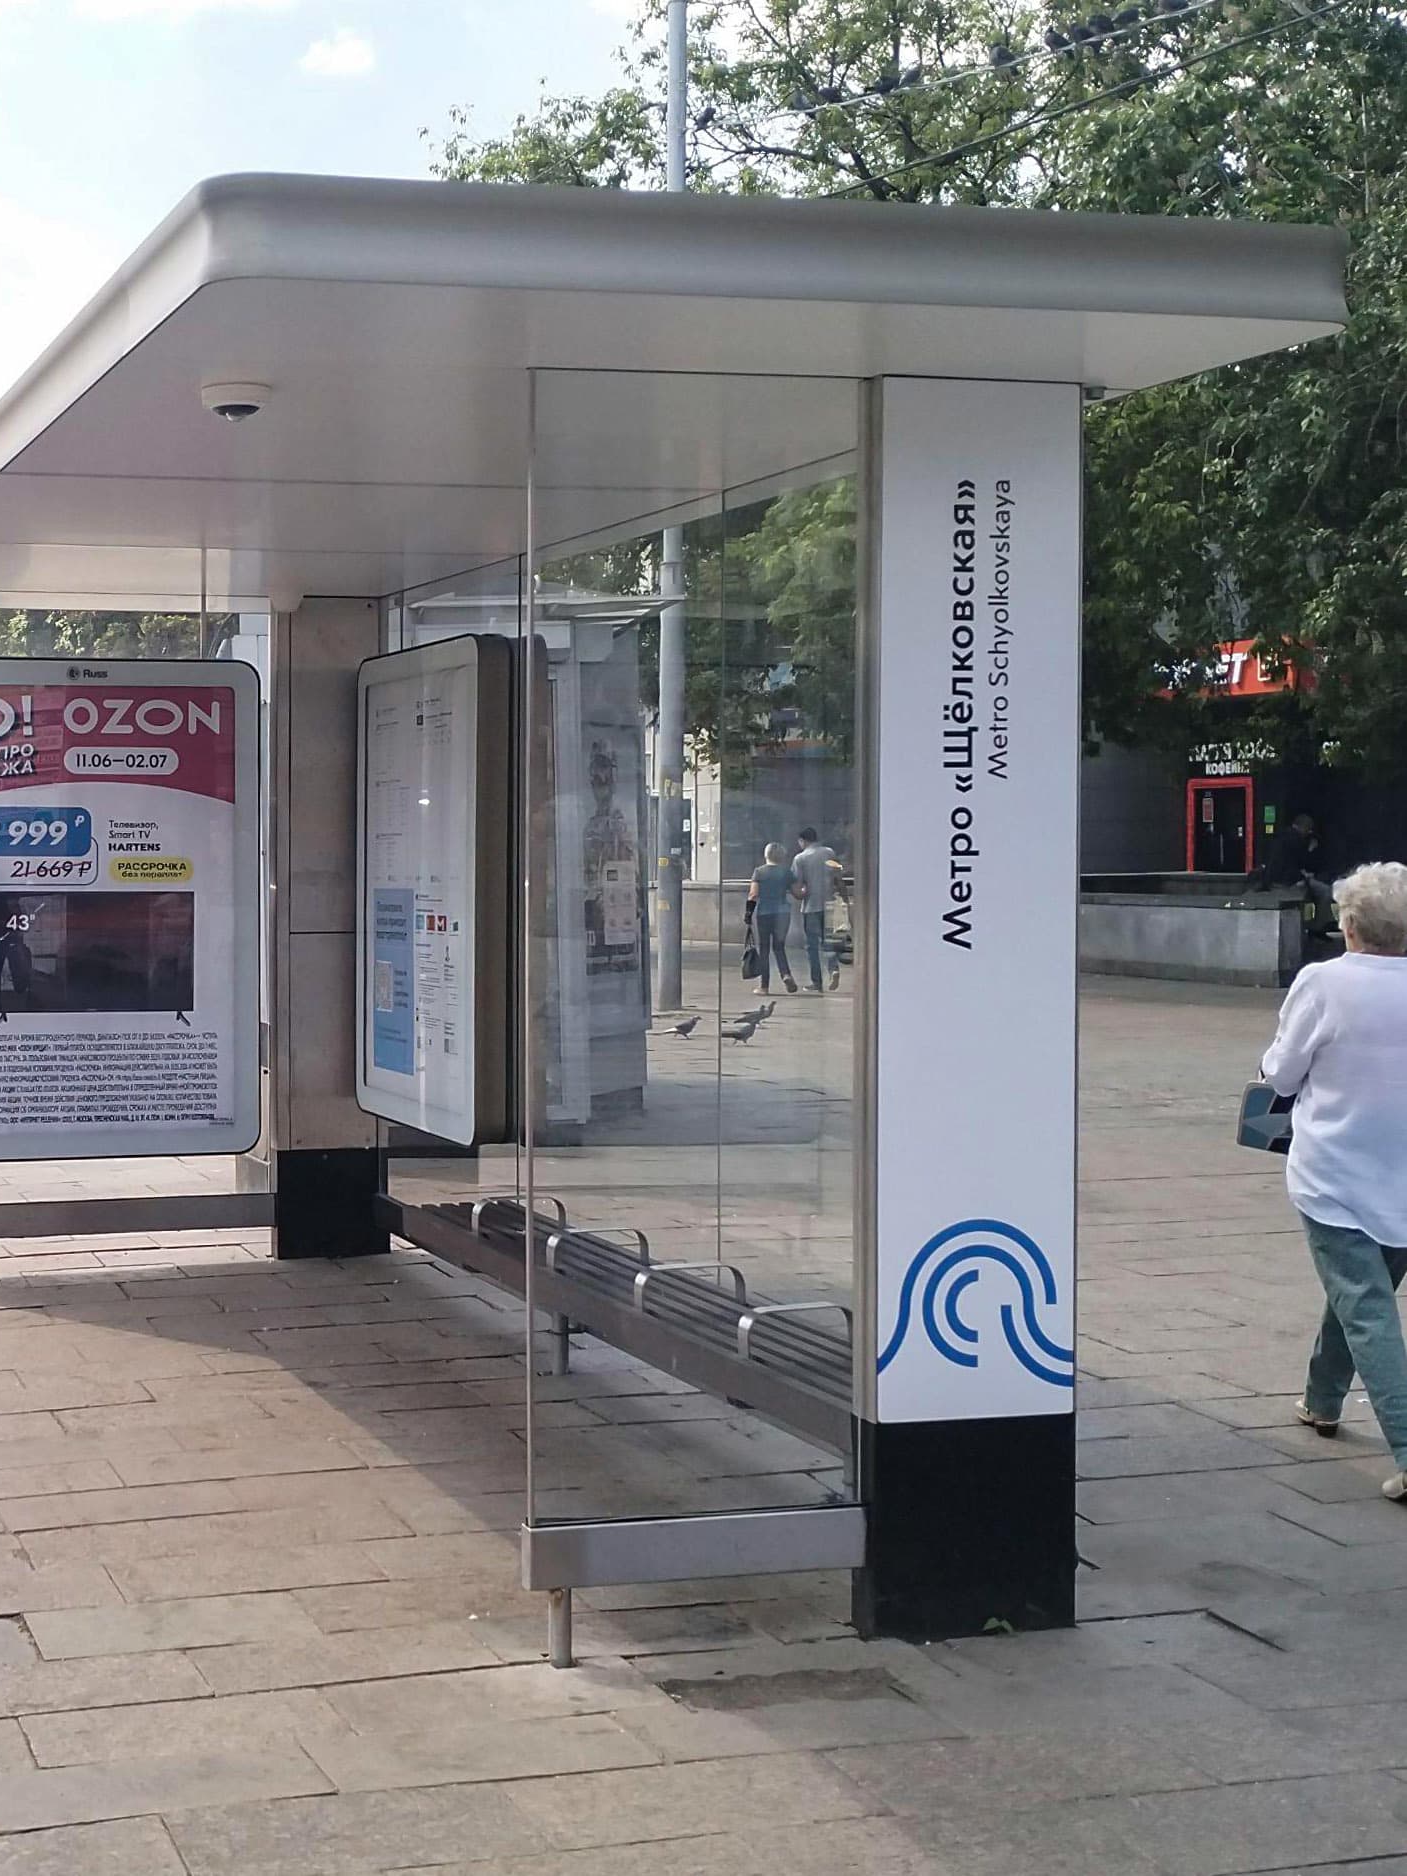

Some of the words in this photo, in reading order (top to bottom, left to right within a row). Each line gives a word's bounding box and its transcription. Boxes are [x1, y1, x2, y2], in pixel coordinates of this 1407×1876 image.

[988, 478, 1015, 687] Schyolkovskaya
[942, 478, 978, 794] «Щёлковская»
[83, 668, 108, 679] Russ
[64, 698, 221, 736] OZON
[988, 694, 1009, 781] Metro
[8, 820, 68, 846] 999
[108, 819, 159, 831] Телевизор,
[108, 830, 135, 839] Smart
[139, 830, 151, 839] TV
[108, 842, 161, 852] HARTENS
[117, 862, 187, 871] РАССРОЧКА
[942, 806, 979, 950] Метро
